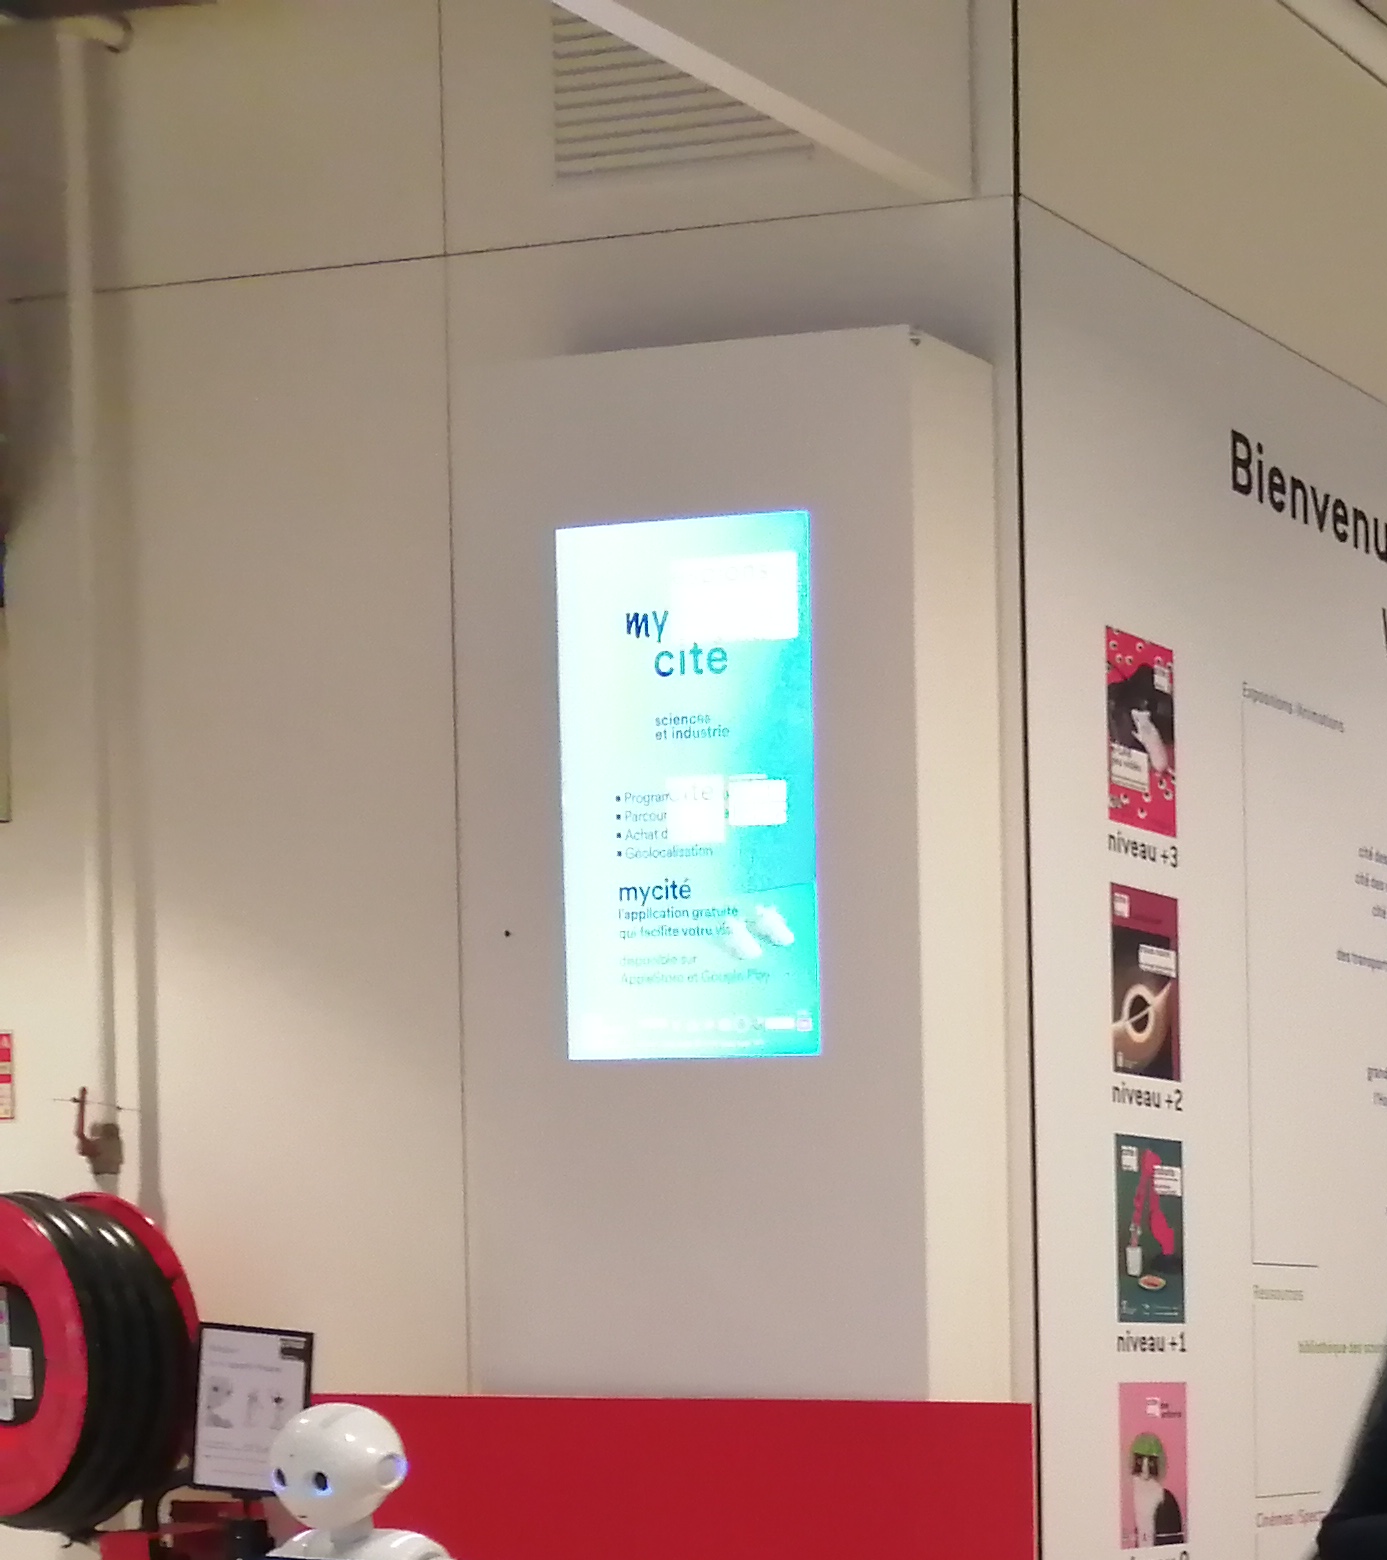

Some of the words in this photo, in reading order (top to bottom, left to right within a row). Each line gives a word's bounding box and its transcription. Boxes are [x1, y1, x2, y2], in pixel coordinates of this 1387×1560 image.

[625, 609, 669, 644] my
[655, 728, 668, 741] et
[671, 724, 730, 740] industrie
[1108, 831, 1157, 863] niveau
[1160, 845, 1179, 869] +3
[618, 876, 692, 907] mycité
[1111, 1081, 1161, 1109] niveau
[1165, 1088, 1184, 1112] +2
[1117, 1330, 1166, 1353] niveau
[1168, 1331, 1188, 1353] +1
